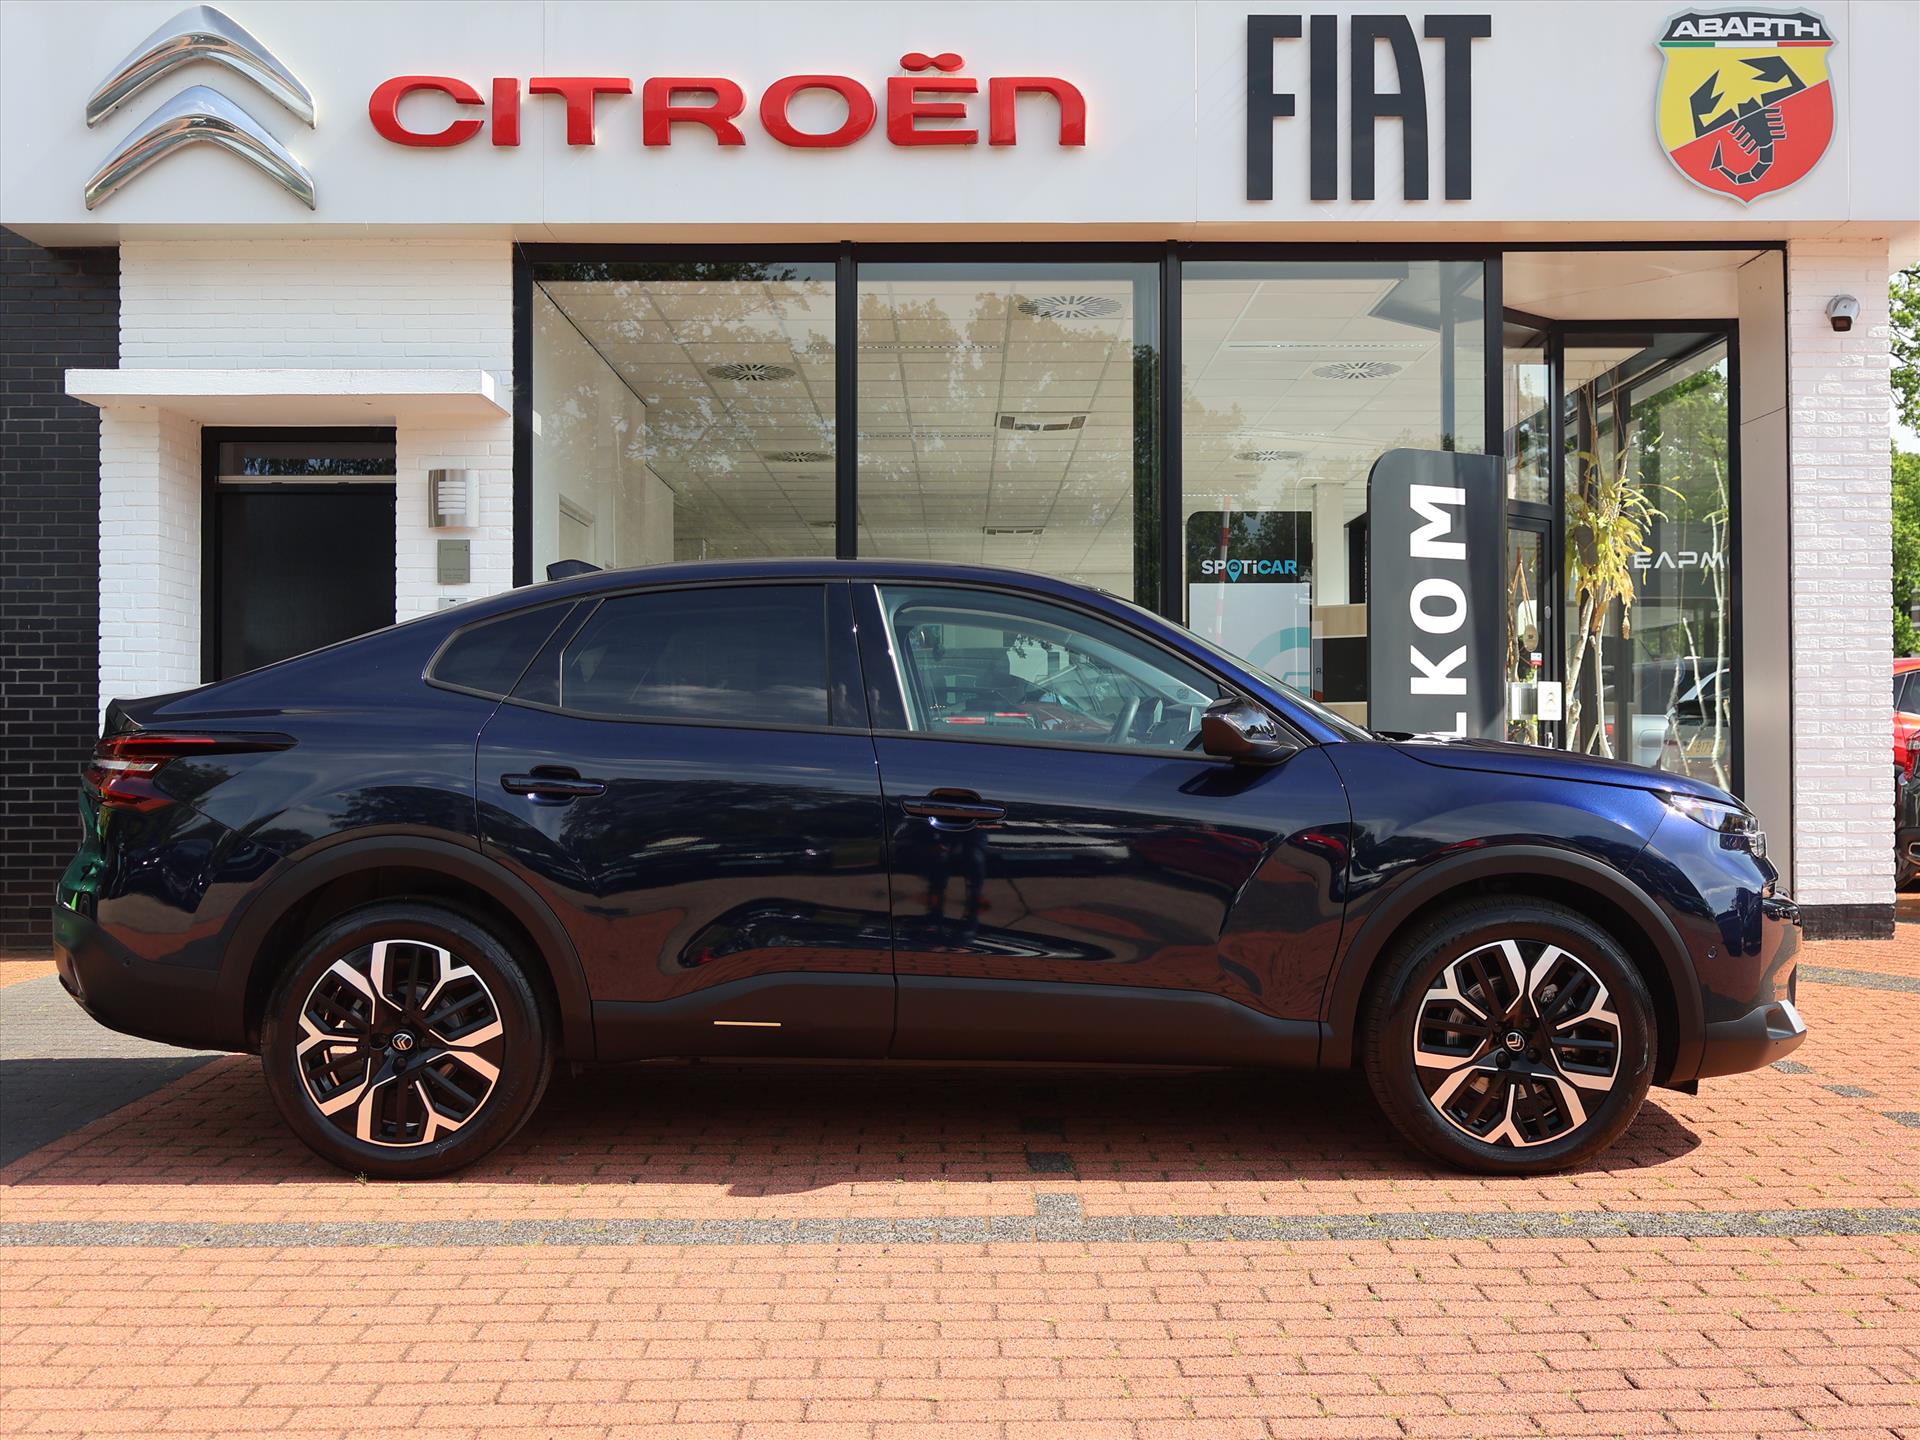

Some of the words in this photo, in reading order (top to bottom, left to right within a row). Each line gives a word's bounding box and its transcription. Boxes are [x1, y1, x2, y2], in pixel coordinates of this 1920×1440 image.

[1671, 16, 1821, 38] ABARTH
[368, 51, 1088, 149] CITROËN
[1246, 14, 1492, 202] FIAT
[1633, 551, 1730, 569] EAPM
